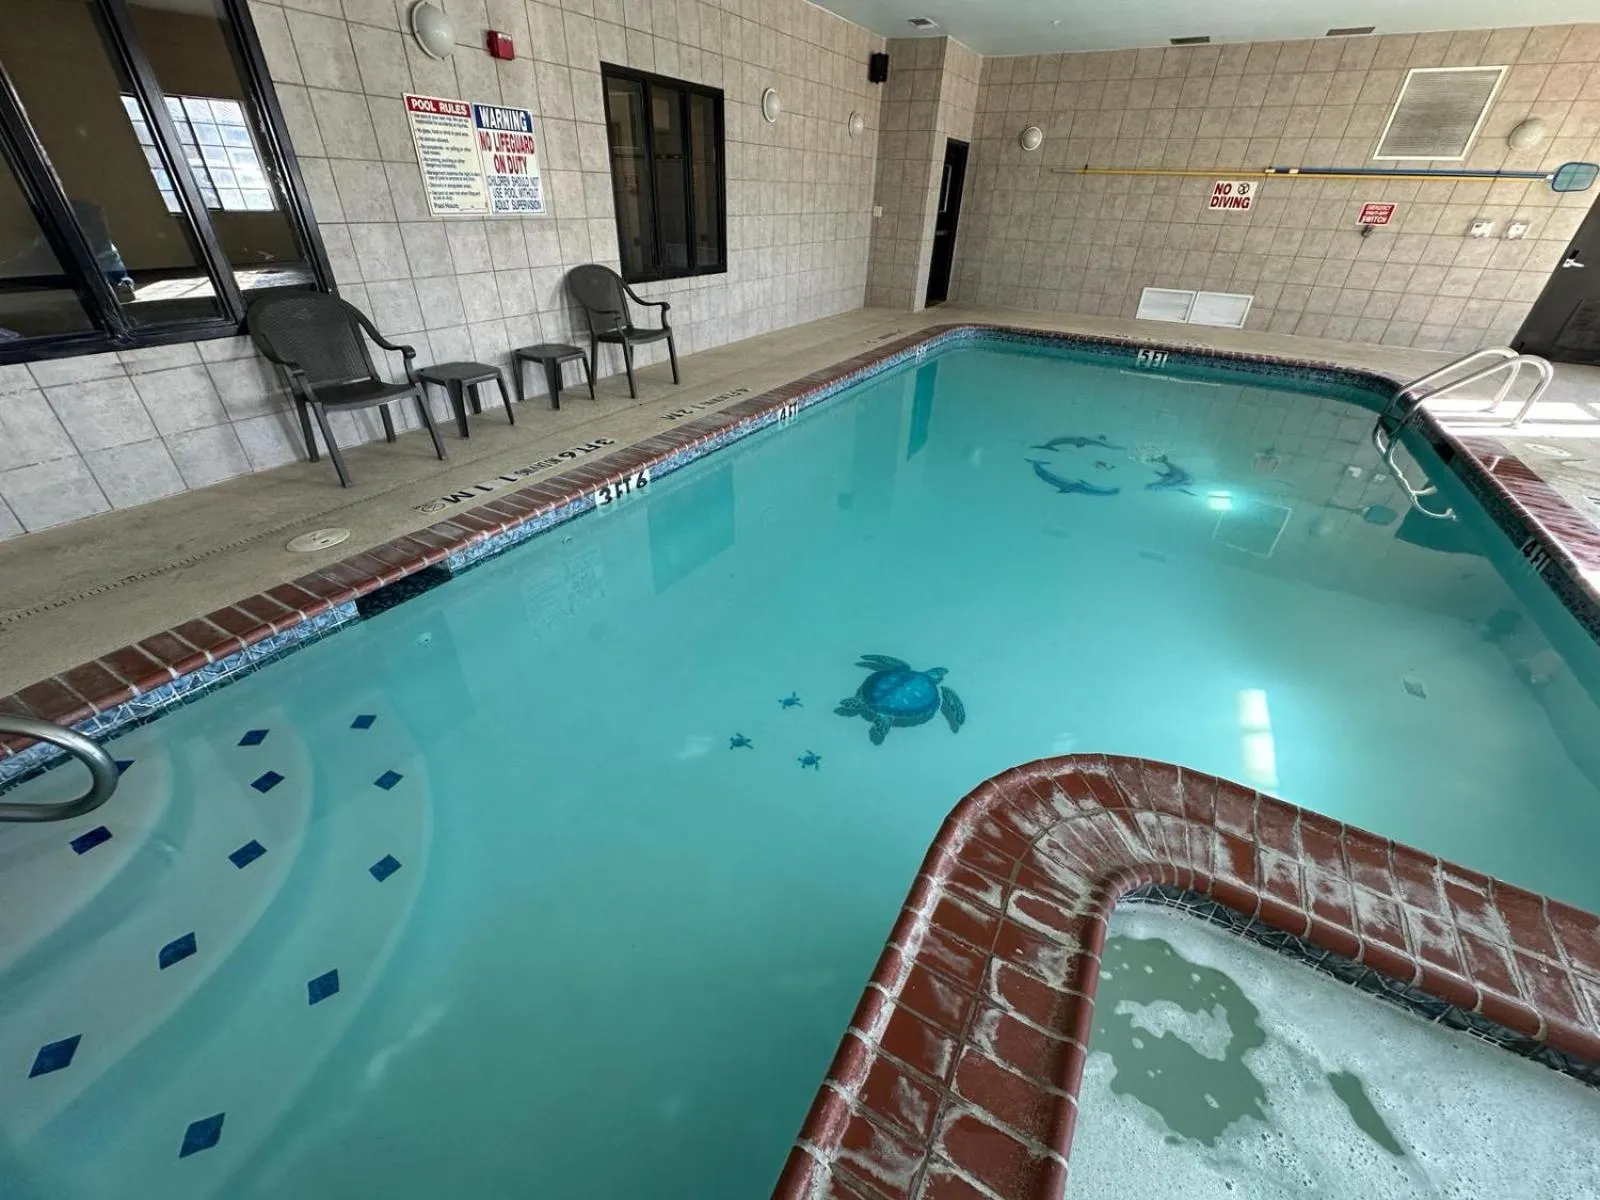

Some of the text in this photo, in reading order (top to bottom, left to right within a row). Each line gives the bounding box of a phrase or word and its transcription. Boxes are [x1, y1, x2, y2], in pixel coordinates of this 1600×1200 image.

[411, 98, 468, 115] POOL RULES
[479, 106, 528, 131] WARNING
[479, 131, 492, 152] NO
[493, 132, 535, 154] LIFEGUARD
[494, 155, 527, 175] ON DUTY
[487, 176, 539, 187] CHILDREN SHOULD NOT
[493, 188, 539, 199] USE POOL WITHOUT
[1214, 183, 1232, 195] NO
[494, 200, 541, 210] ADULT SUPERVISION
[1210, 196, 1250, 208] DIVING
[558, 451, 577, 459] 6
[599, 470, 648, 506] 3 FT 6
[441, 491, 476, 503] M
